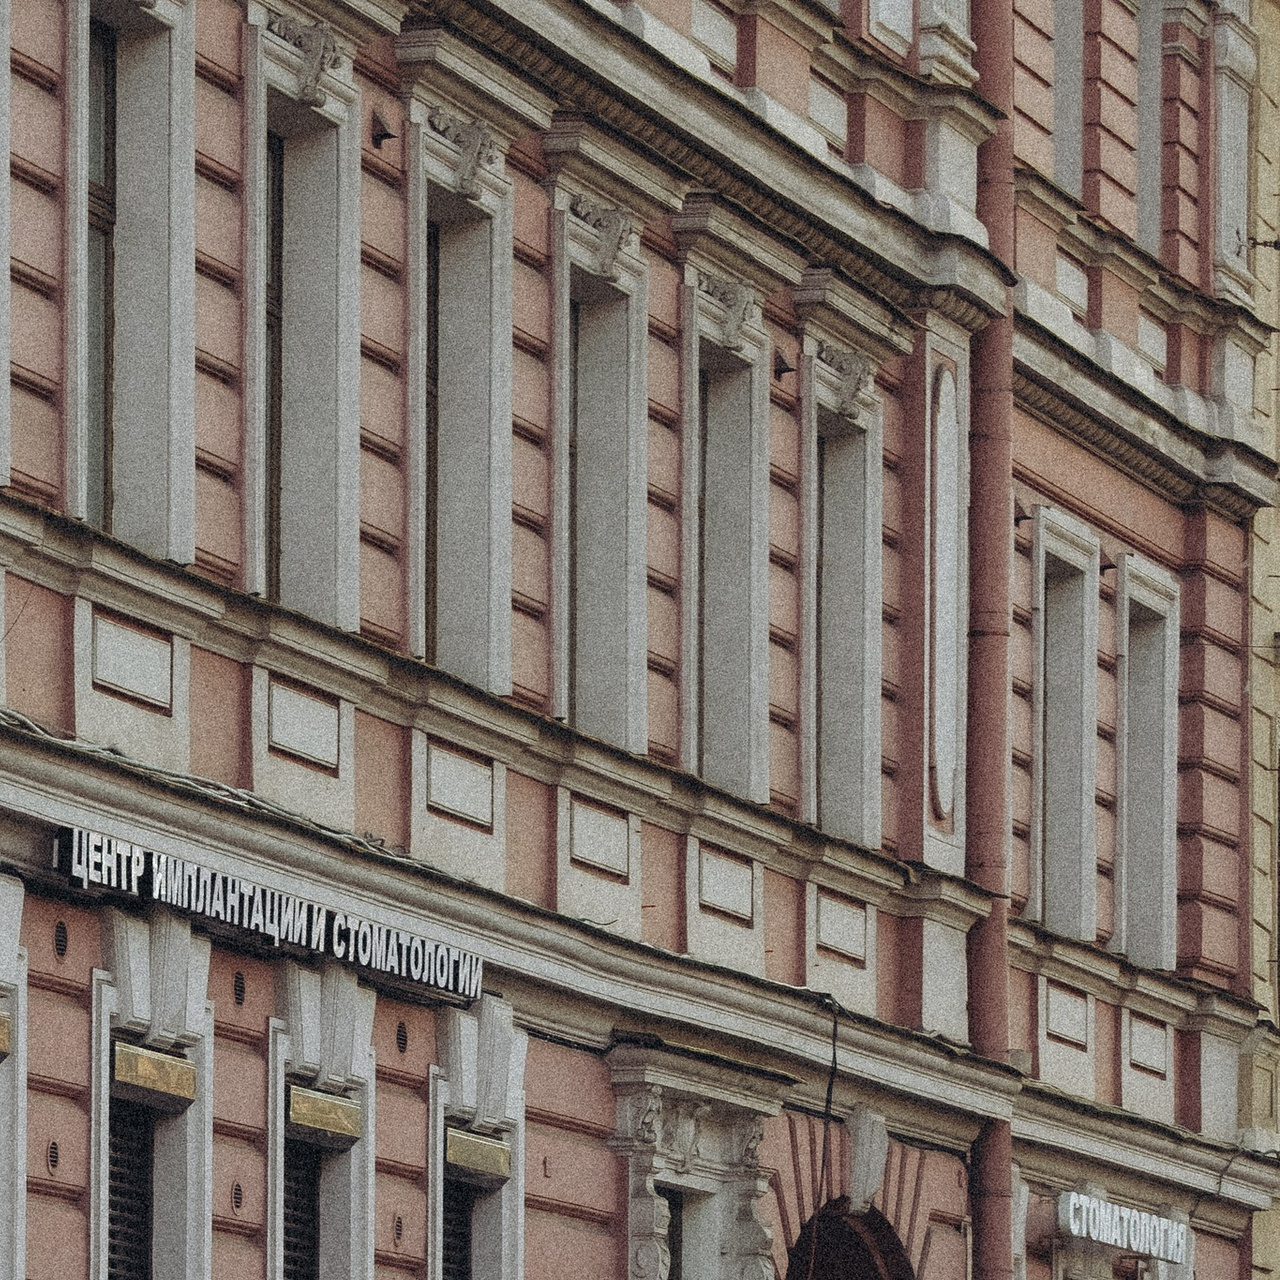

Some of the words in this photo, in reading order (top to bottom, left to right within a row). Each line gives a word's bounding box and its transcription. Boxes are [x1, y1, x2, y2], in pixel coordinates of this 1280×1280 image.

[72, 828, 144, 896] ЦЕНТР
[152, 854, 307, 946] ИМПЛАНТАЦИИ
[311, 904, 325, 952] И
[332, 913, 483, 999] СТОМАТОЛОГИИ
[1069, 1191, 1187, 1264] СТОМАТОЛОГИЯ
